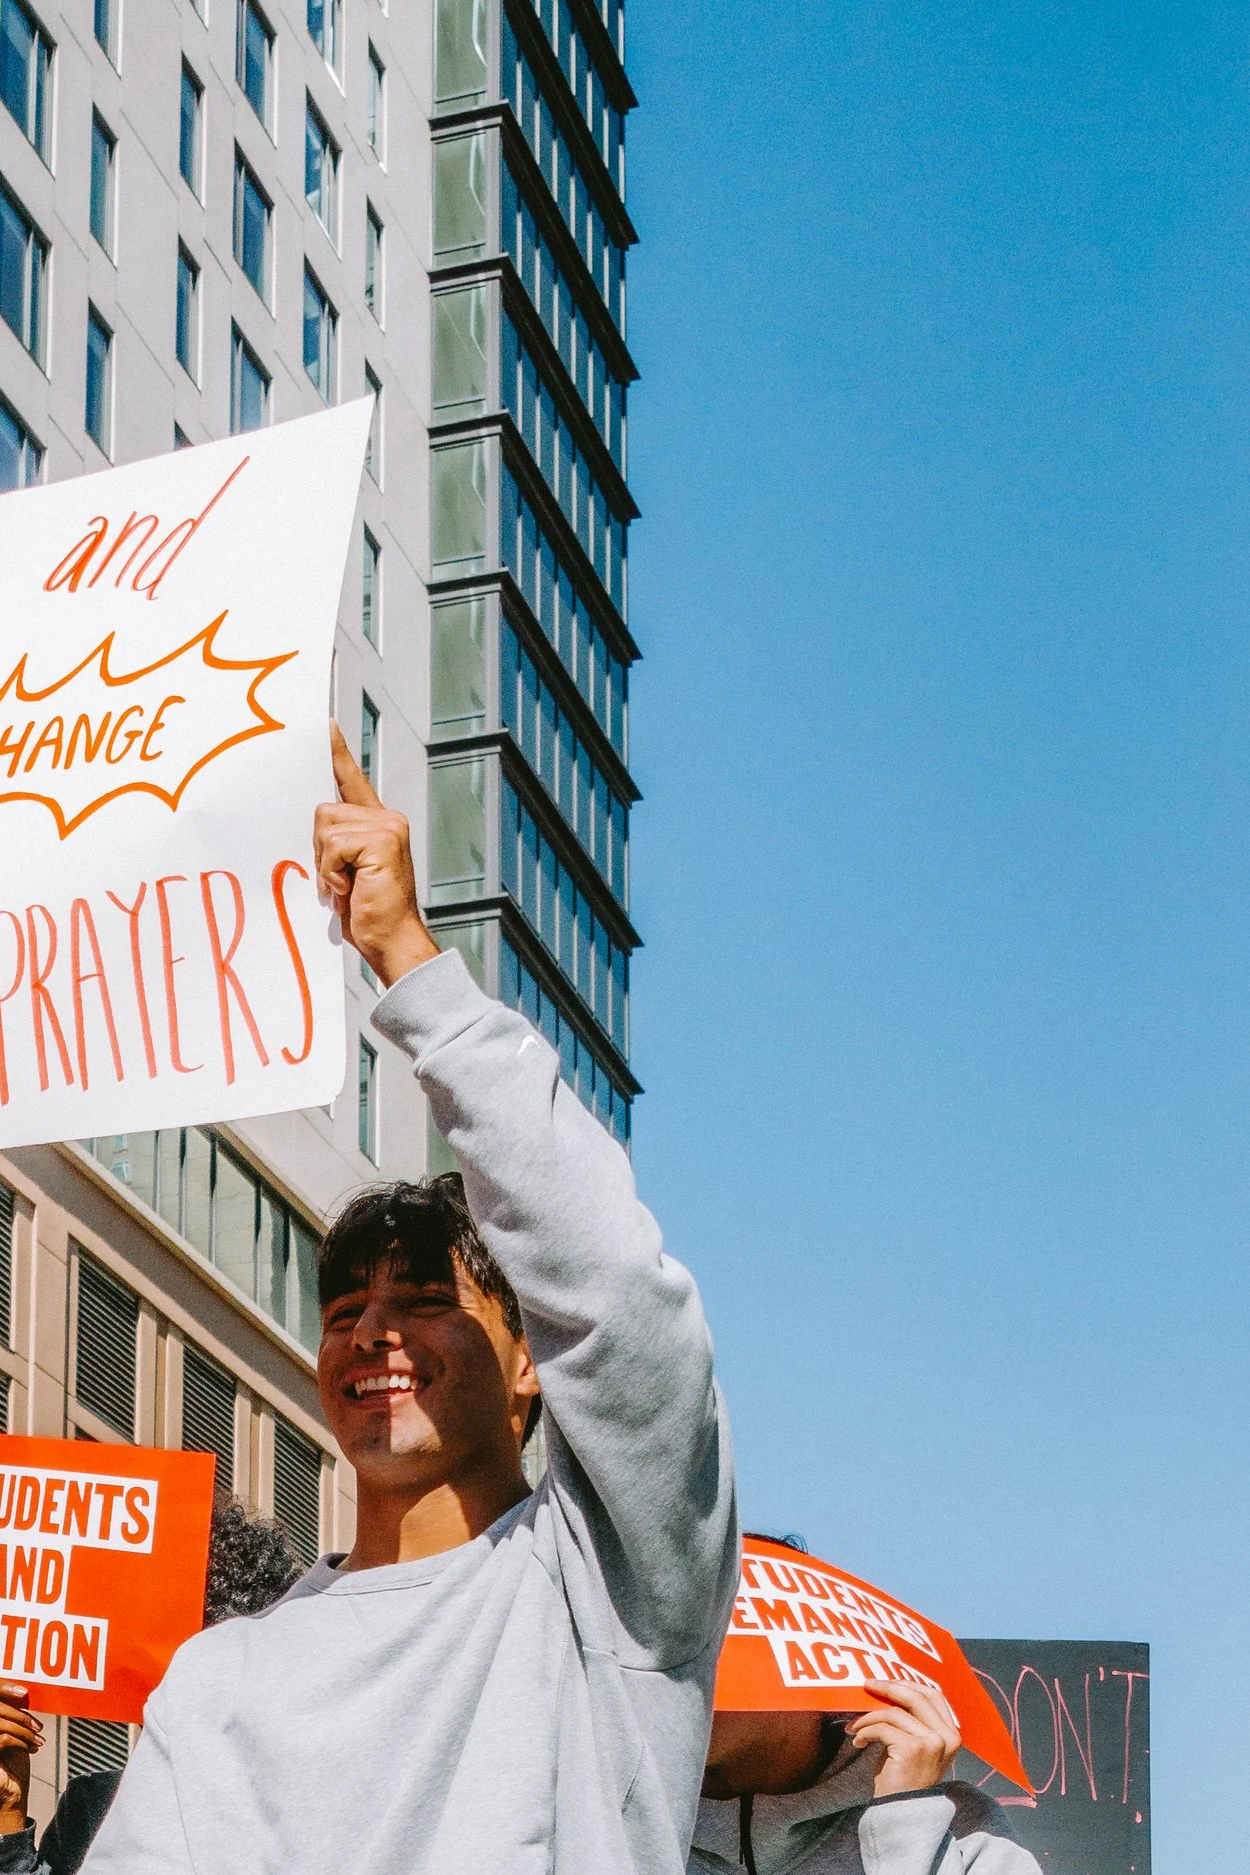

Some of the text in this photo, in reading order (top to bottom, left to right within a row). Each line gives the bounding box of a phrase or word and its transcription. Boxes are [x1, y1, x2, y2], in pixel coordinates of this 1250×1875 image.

[43, 455, 251, 602] and
[731, 1597, 890, 1651] EMAND
[741, 1558, 934, 1653] TUDENTS
[785, 1640, 936, 1682] ACTI
